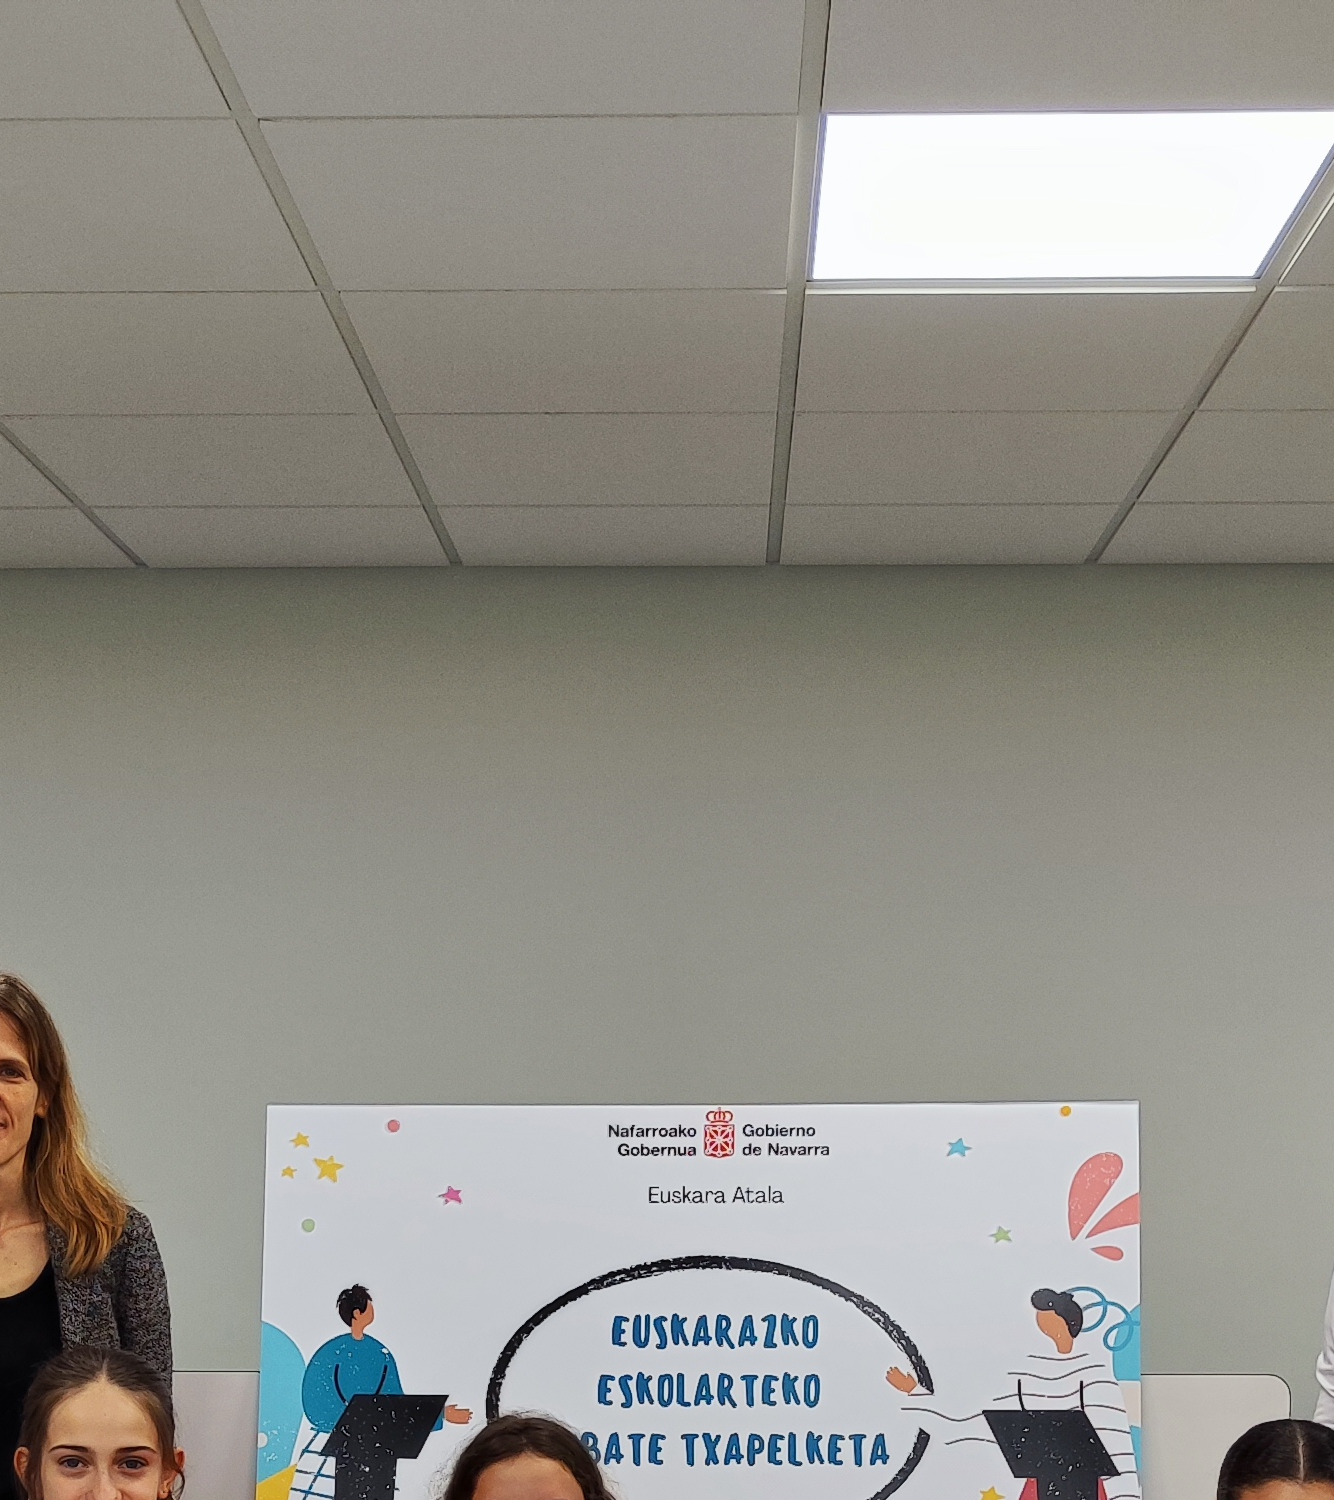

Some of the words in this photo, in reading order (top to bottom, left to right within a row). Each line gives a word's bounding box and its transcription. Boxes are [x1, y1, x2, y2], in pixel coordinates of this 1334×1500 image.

[608, 1124, 697, 1138] Nafarroako
[742, 1124, 815, 1138] Gobierno
[617, 1143, 697, 1156] Gobernua
[742, 1143, 761, 1156] de
[768, 1143, 829, 1156] Navarra
[648, 1186, 725, 1204] Euskara
[732, 1186, 784, 1204] Atala
[611, 1312, 819, 1349] EUSKARAZKO
[597, 1371, 821, 1408] ESKOLARTEKO
[580, 1431, 666, 1466] BATE
[680, 1431, 890, 1467] TXAPELKETA
